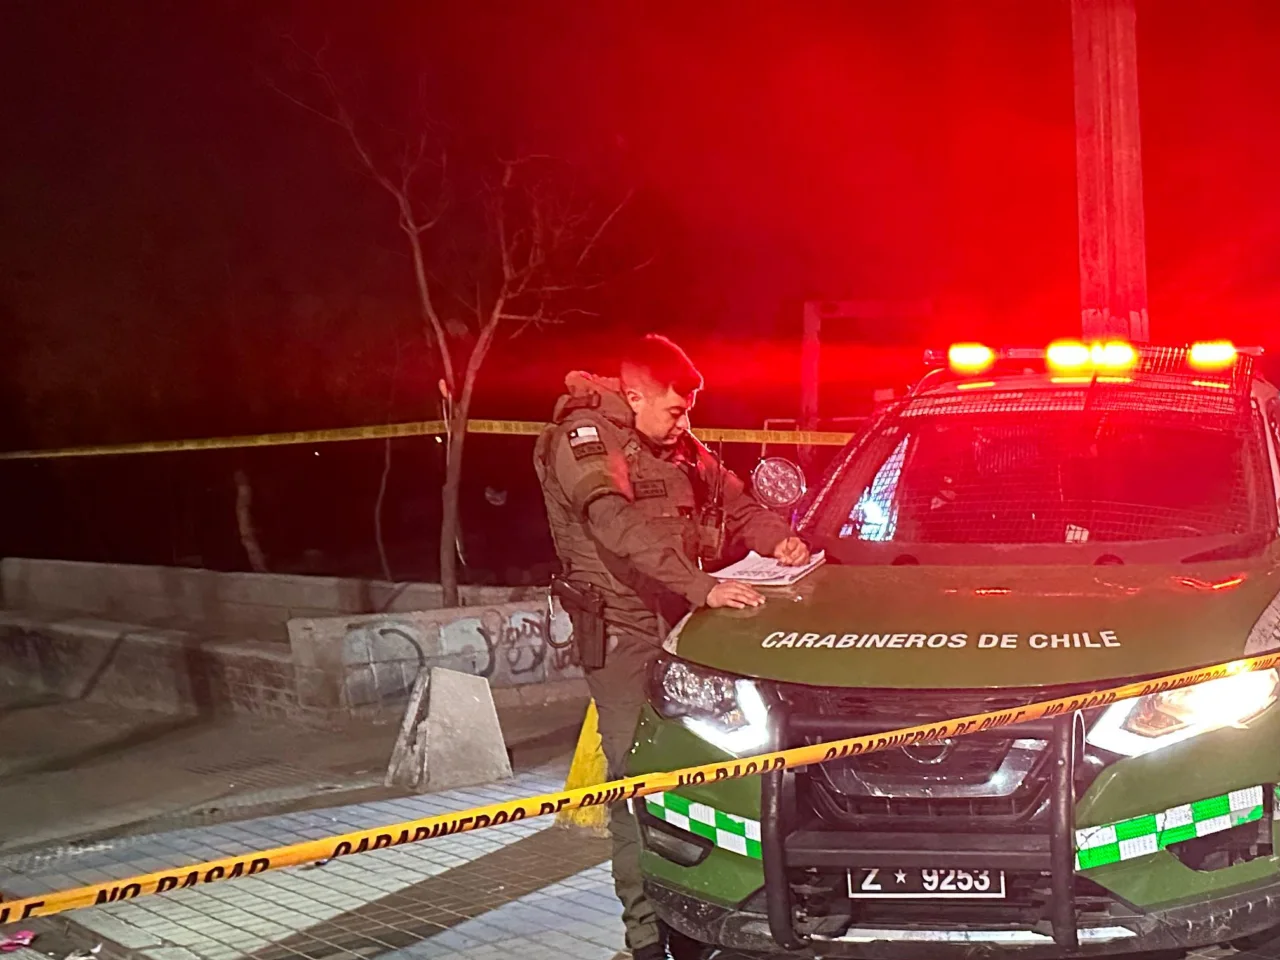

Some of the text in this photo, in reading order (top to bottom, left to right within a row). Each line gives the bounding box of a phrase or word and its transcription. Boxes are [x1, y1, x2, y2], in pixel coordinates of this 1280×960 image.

[761, 630, 1122, 649] CARABINEROS DE CHILE
[861, 868, 991, 892] Z 9253
